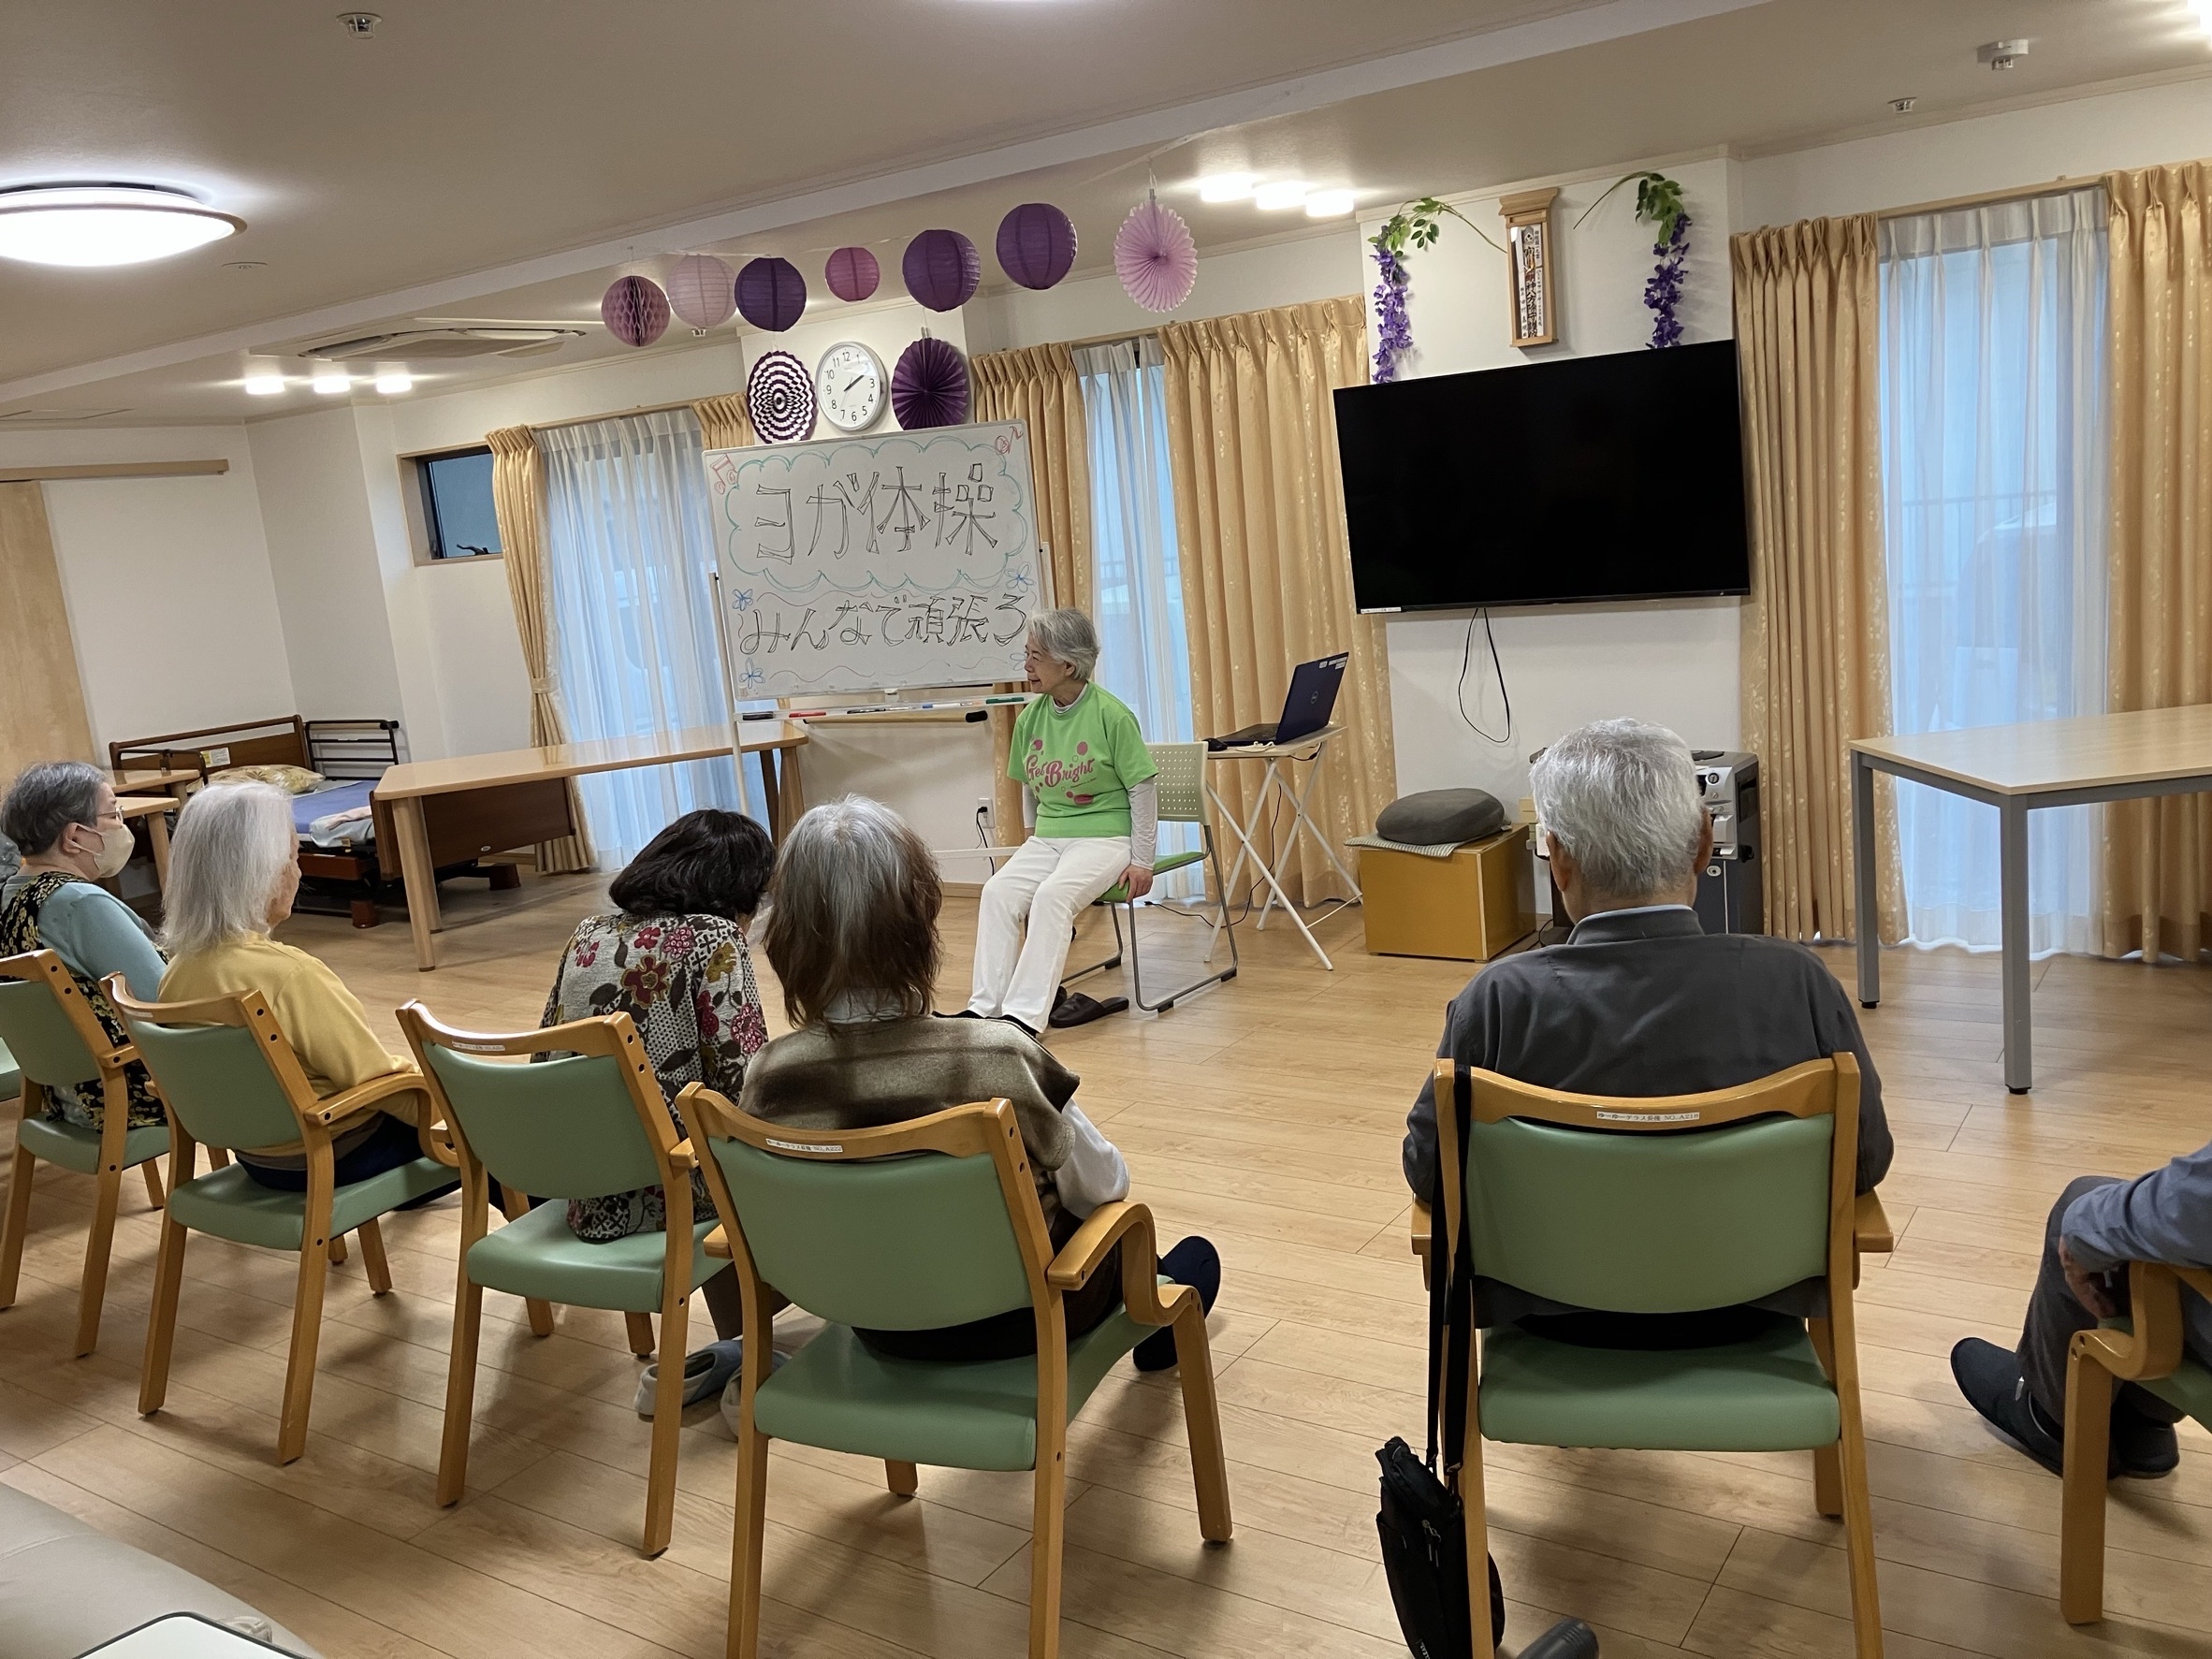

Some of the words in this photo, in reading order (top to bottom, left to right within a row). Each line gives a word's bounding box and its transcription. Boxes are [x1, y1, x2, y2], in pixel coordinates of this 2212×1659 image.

[842, 351, 851, 362] 12
[856, 354, 861, 364] 1
[832, 357, 840, 368] 11
[826, 369, 835, 380] 10
[869, 378, 875, 388] 3
[826, 385, 832, 395] 9
[867, 393, 874, 403] 4
[831, 400, 837, 410] 8
[862, 405, 867, 415] 5
[840, 409, 845, 419] 7
[851, 411, 857, 422] 6
[754, 462, 998, 565] ヨガ体操
[1026, 754, 1047, 781] Get
[1044, 758, 1096, 788] Bright
